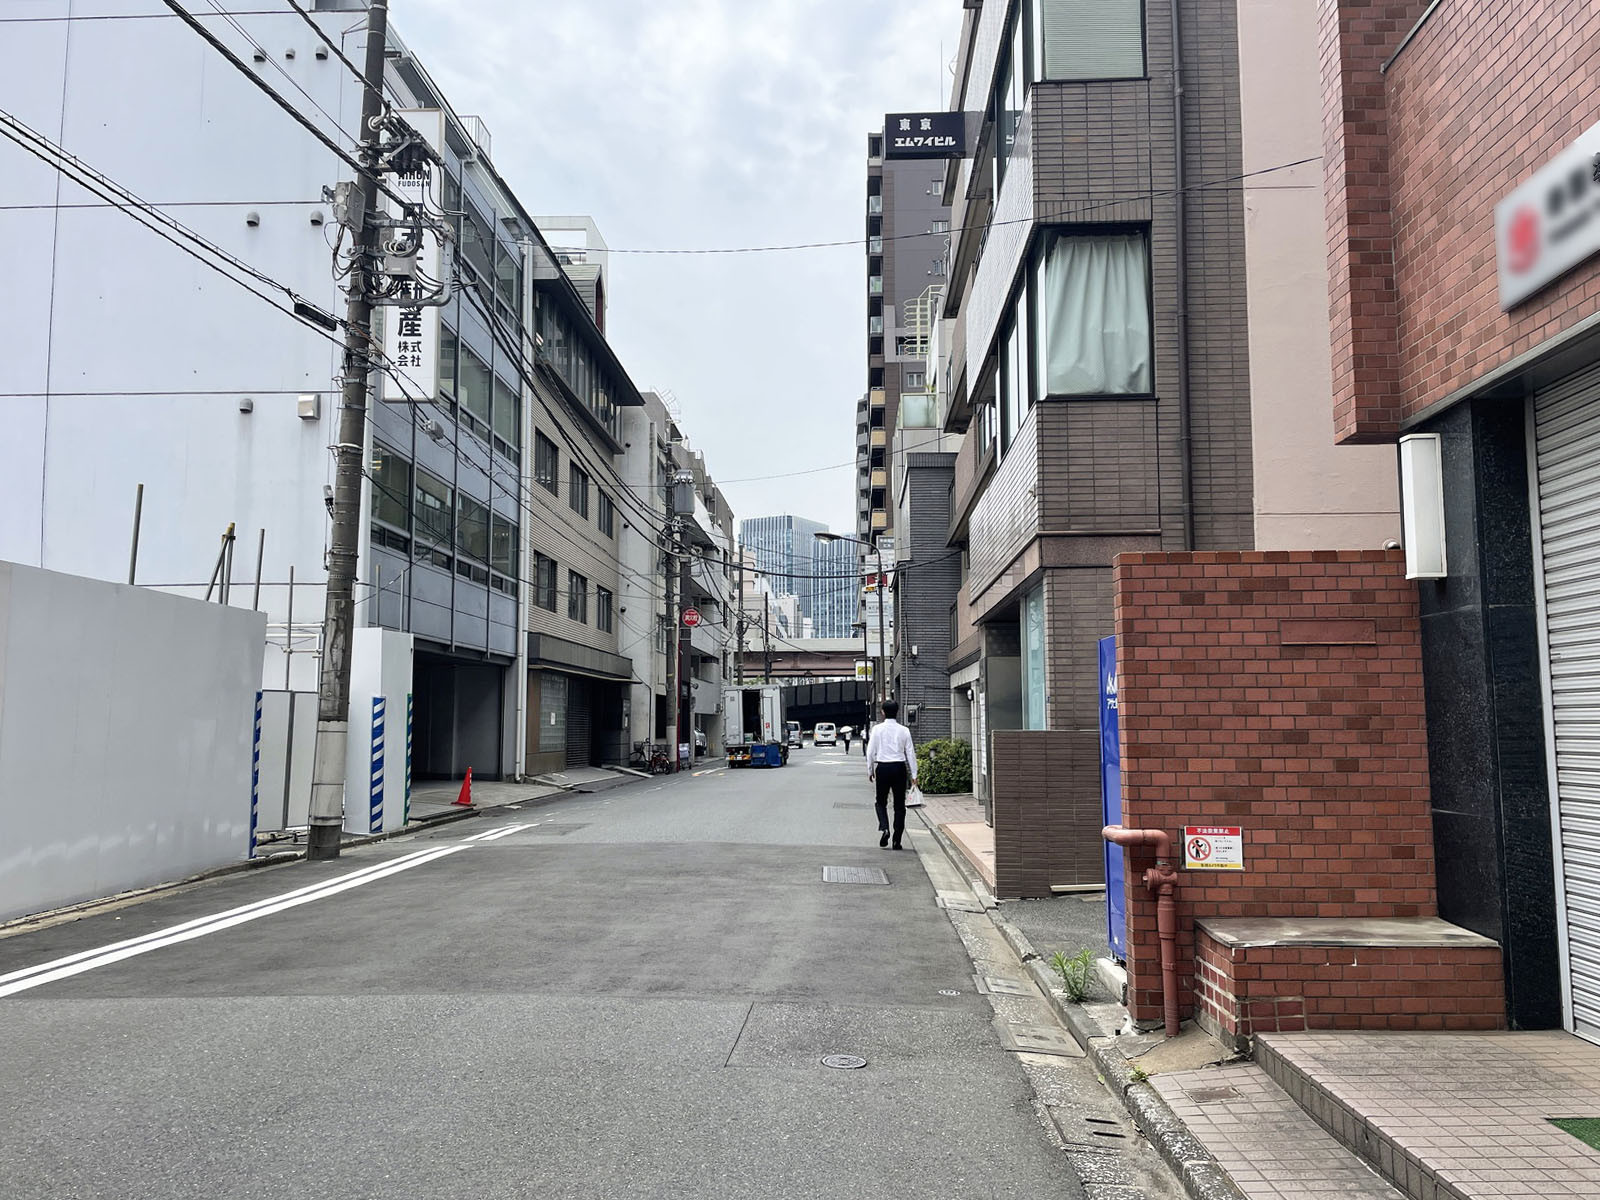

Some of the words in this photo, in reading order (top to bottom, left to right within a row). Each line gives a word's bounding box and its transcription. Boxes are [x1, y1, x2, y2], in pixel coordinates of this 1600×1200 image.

[899, 118, 932, 131] 東京
[894, 136, 956, 147] エムワイビル
